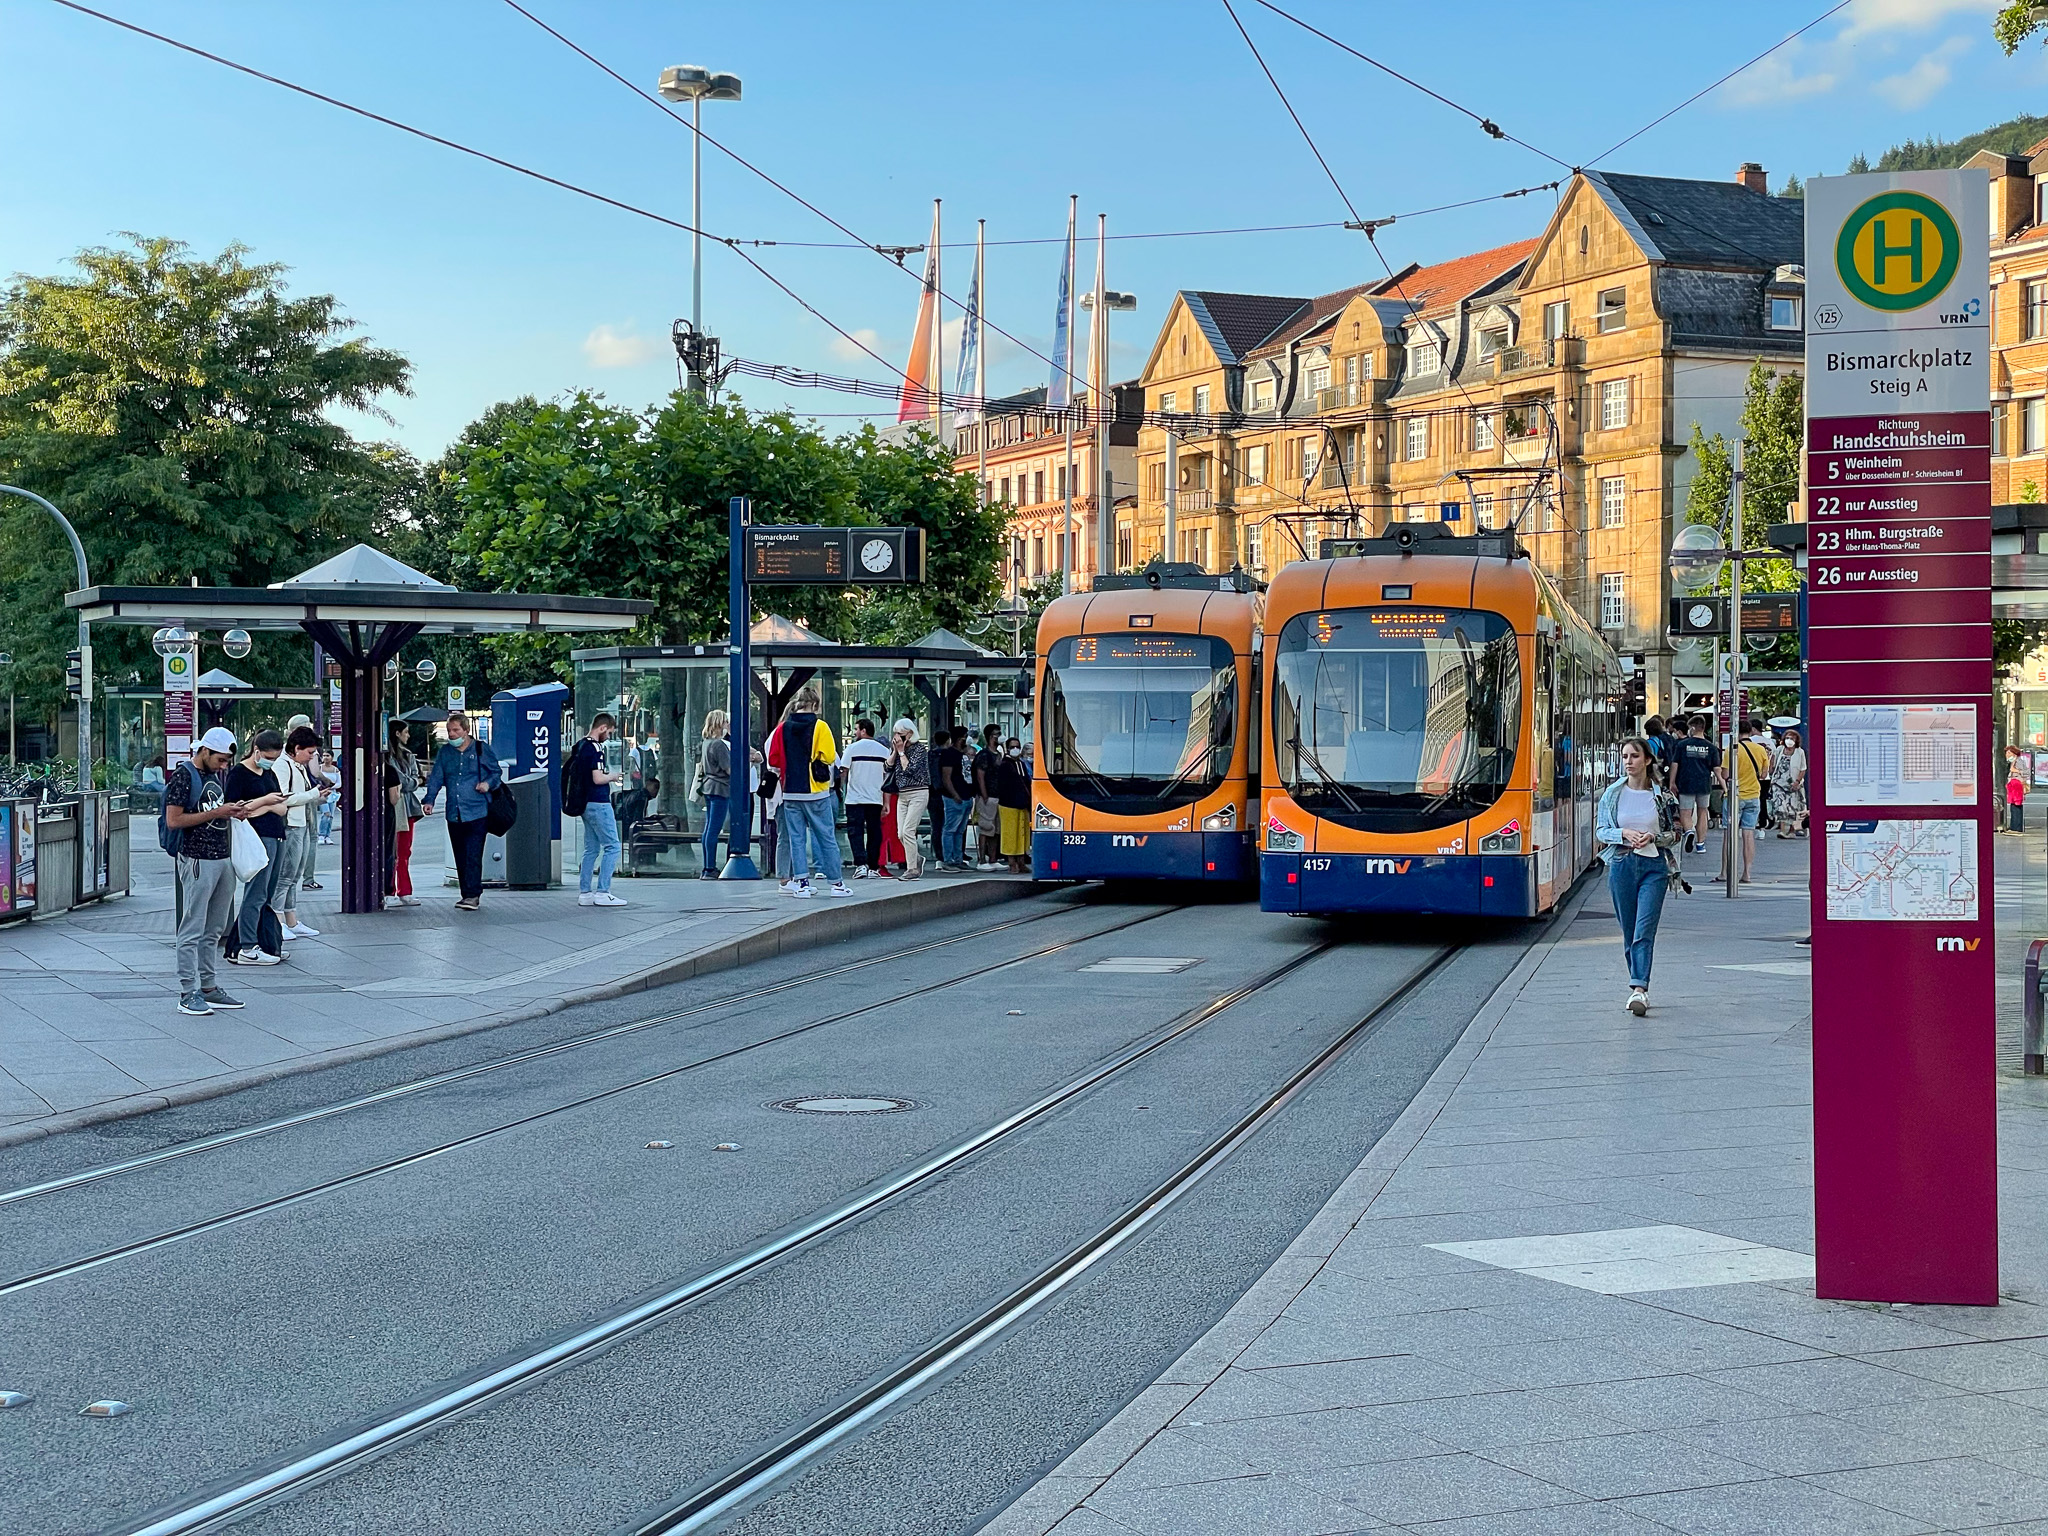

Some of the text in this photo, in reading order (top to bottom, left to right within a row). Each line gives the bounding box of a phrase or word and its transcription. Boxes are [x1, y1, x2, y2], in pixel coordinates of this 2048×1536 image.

[1874, 218, 1922, 285] H
[1819, 312, 1838, 324] 125
[1940, 313, 1969, 324] VRN
[1827, 348, 1972, 373] Bismarckplatz
[1870, 378, 1928, 397] Steig A
[1878, 420, 1920, 431] Richtung
[1833, 431, 1966, 450] Handschuhsheim
[1828, 456, 1903, 480] 5 Weinheim
[1845, 472, 1860, 481] über
[1861, 471, 1900, 480] Dossenheim
[1915, 470, 1954, 478] Schriesheim
[1445, 505, 1456, 519] T
[1817, 497, 1918, 515] 22 nur Ausstieg
[754, 533, 800, 542] Bismarckplatz
[1817, 525, 1943, 550] 23 Hhm. Burgstraße
[1845, 542, 1921, 551] über Hans-Thoma-Platz
[1817, 567, 1919, 585] 26 nur Ausstieg
[174, 660, 181, 671] H
[530, 726, 549, 773] kets
[1063, 834, 1087, 845] 3282
[1112, 834, 1149, 847] rnv
[1303, 858, 1332, 871] 4157
[1366, 858, 1412, 874] rnv
[1936, 937, 1981, 952] rnv
